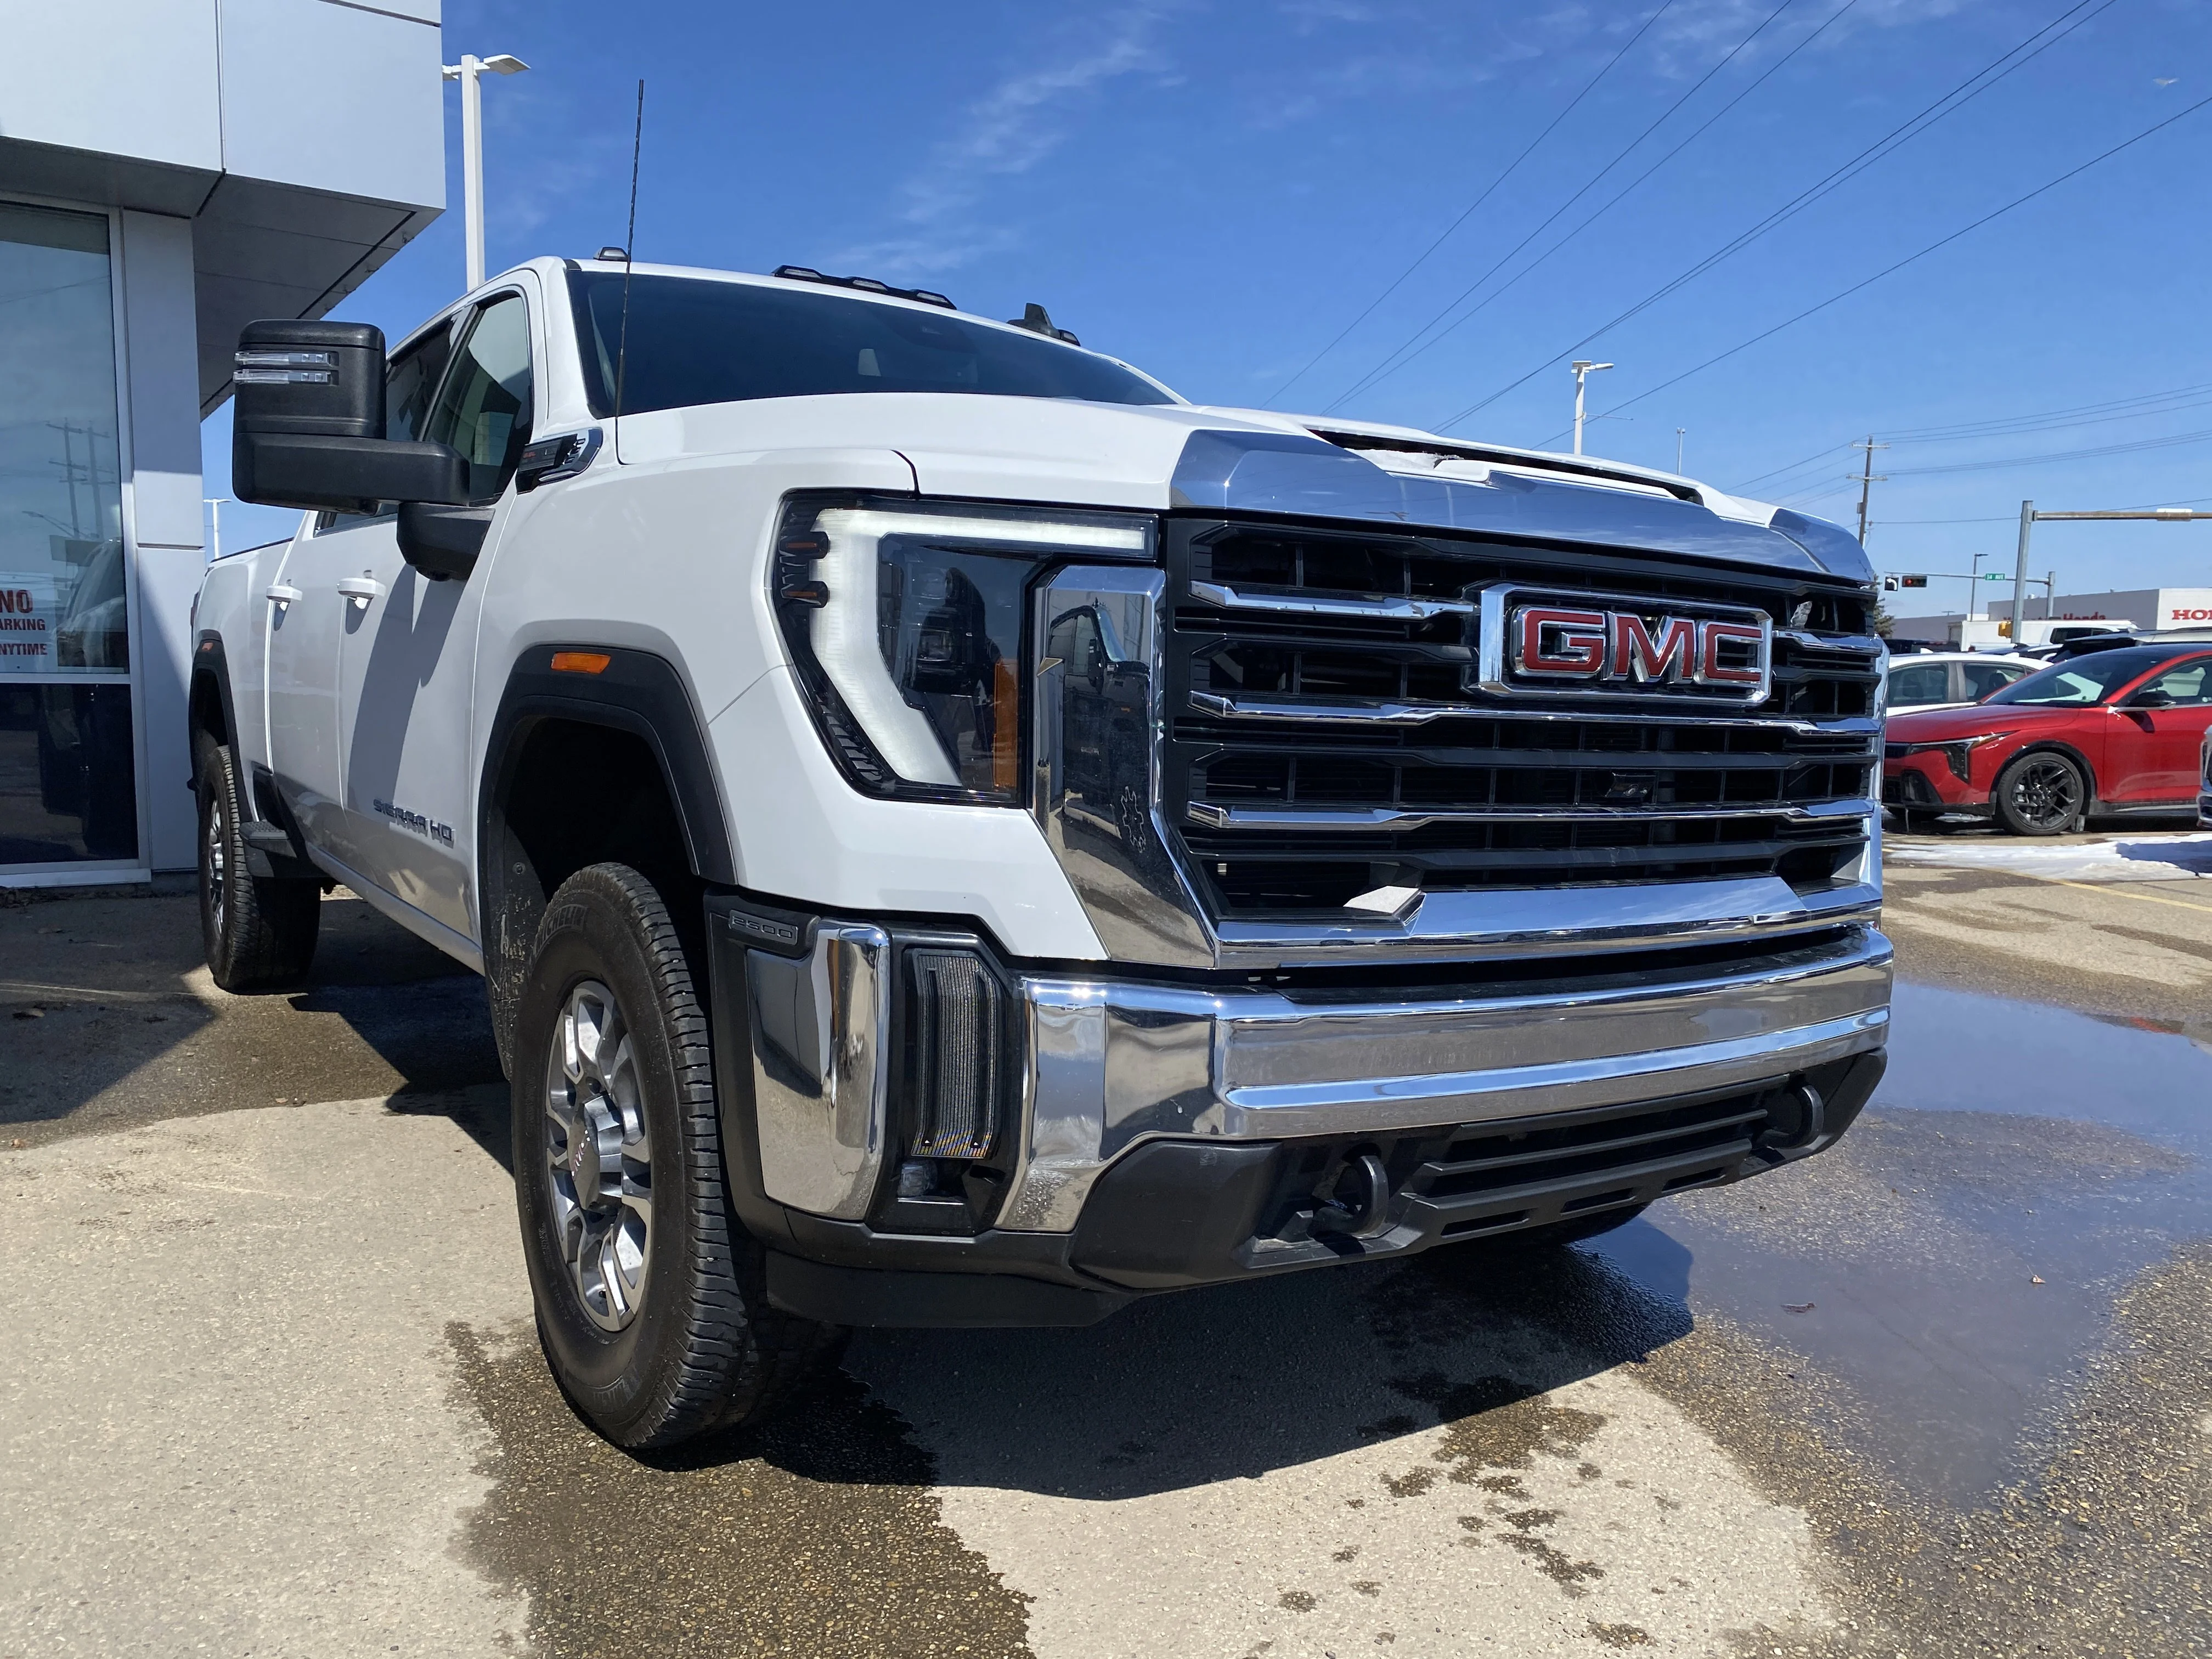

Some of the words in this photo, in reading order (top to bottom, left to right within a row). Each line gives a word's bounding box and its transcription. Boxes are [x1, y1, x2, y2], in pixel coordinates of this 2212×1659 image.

[0, 590, 33, 613] NO
[2171, 610, 2212, 620] HO
[1514, 606, 1763, 684] GMC
[430, 820, 453, 842] HD
[732, 916, 793, 939] 2500
